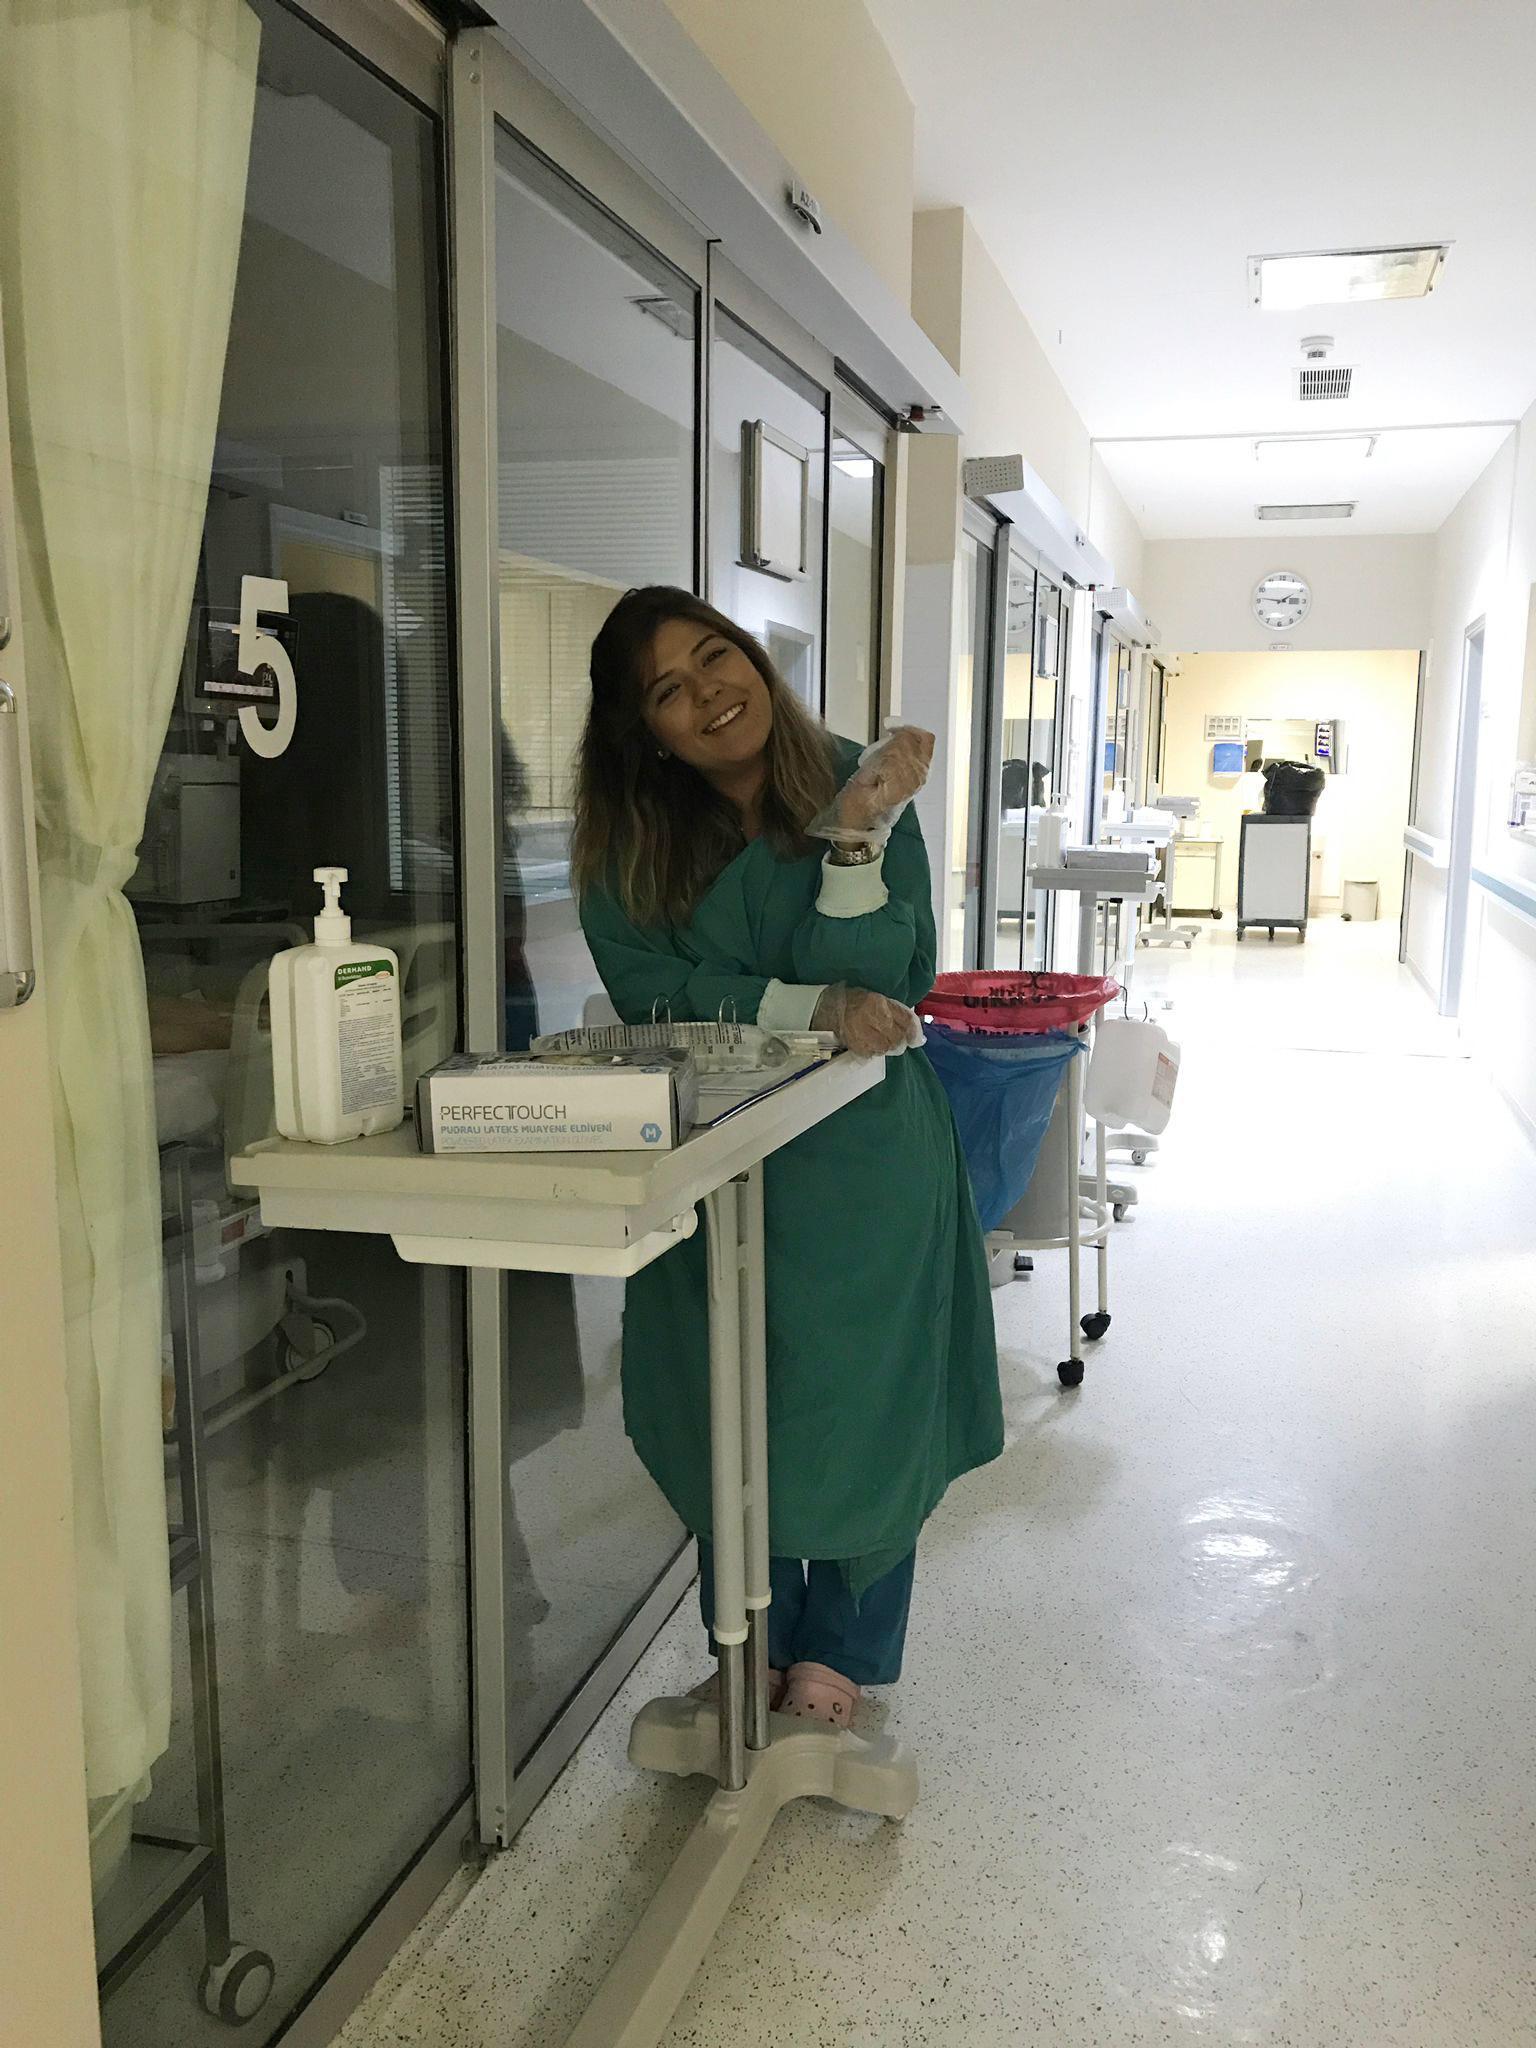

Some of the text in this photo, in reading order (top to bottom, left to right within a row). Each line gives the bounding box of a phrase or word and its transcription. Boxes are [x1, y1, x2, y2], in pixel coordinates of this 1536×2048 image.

[238, 575, 297, 758] 5
[484, 1125, 518, 1134] LATEKS
[521, 1124, 567, 1134] MUAYENE
[645, 1128, 656, 1138] M
